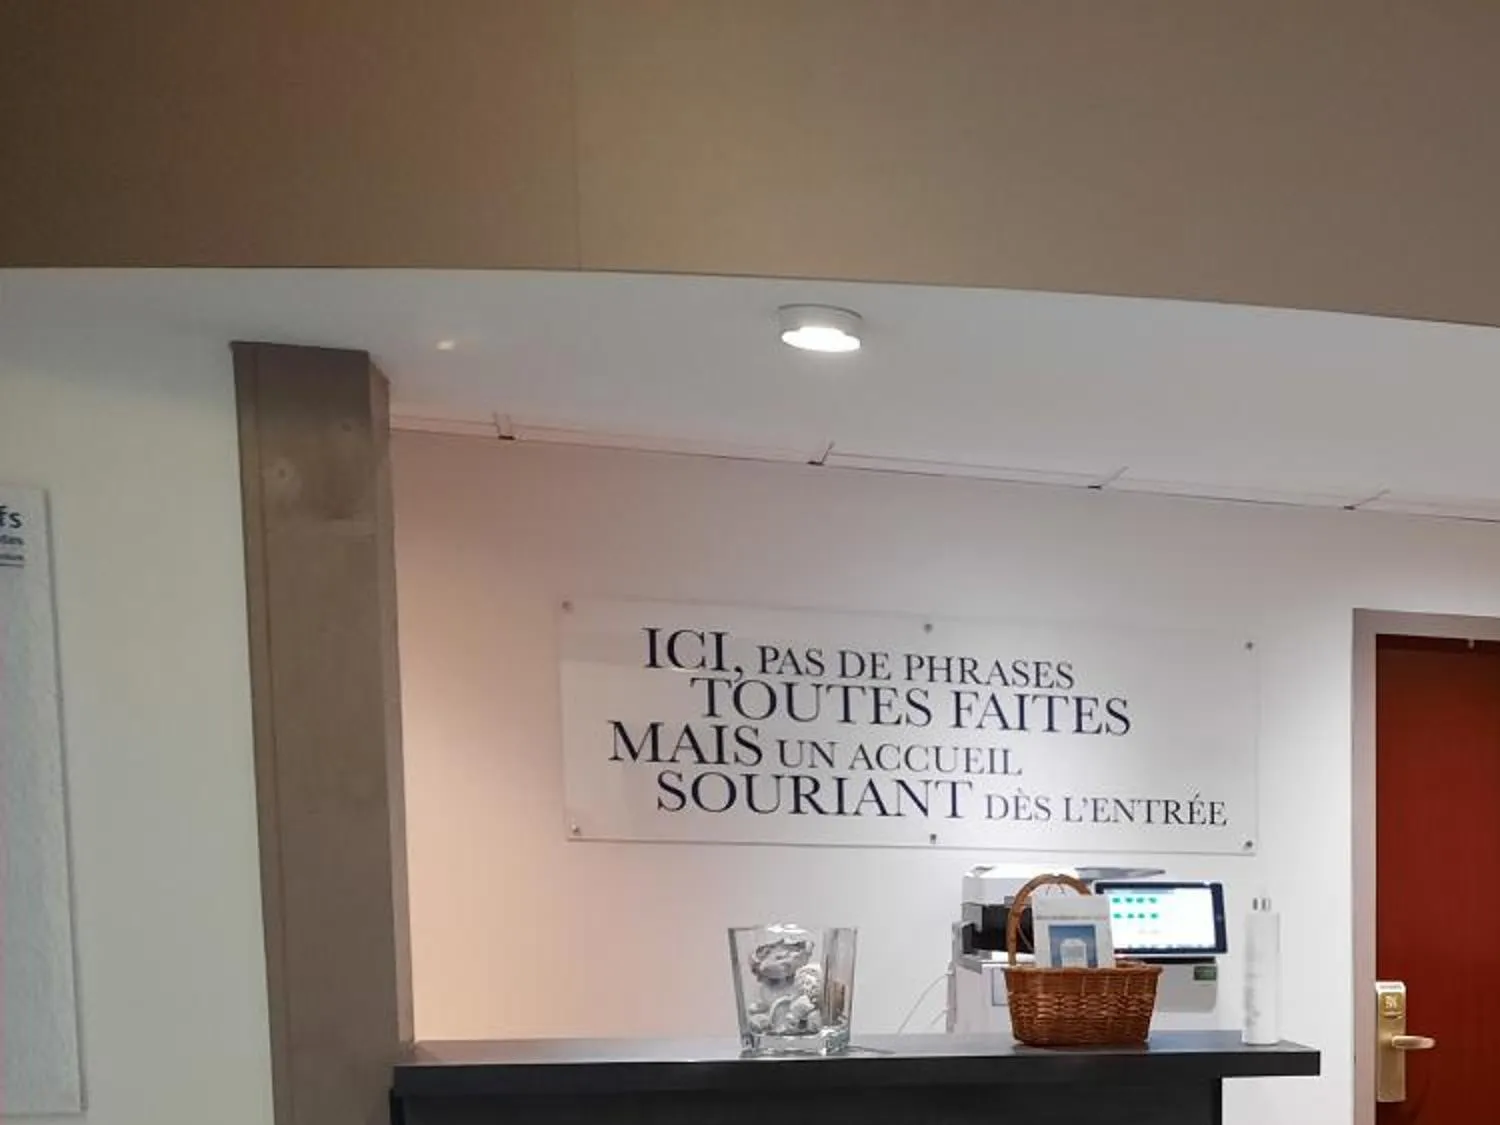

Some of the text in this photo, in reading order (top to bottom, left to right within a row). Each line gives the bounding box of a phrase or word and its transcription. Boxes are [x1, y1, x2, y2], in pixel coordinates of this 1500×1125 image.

[642, 627, 1075, 690] ICI, PAS DE PHRASES
[690, 676, 1131, 736] TOUTES FAITES
[607, 720, 1023, 777] MAIS UN ACCUEIL
[656, 769, 1228, 828] SOURIANT DÈS L'ENTRÉE
